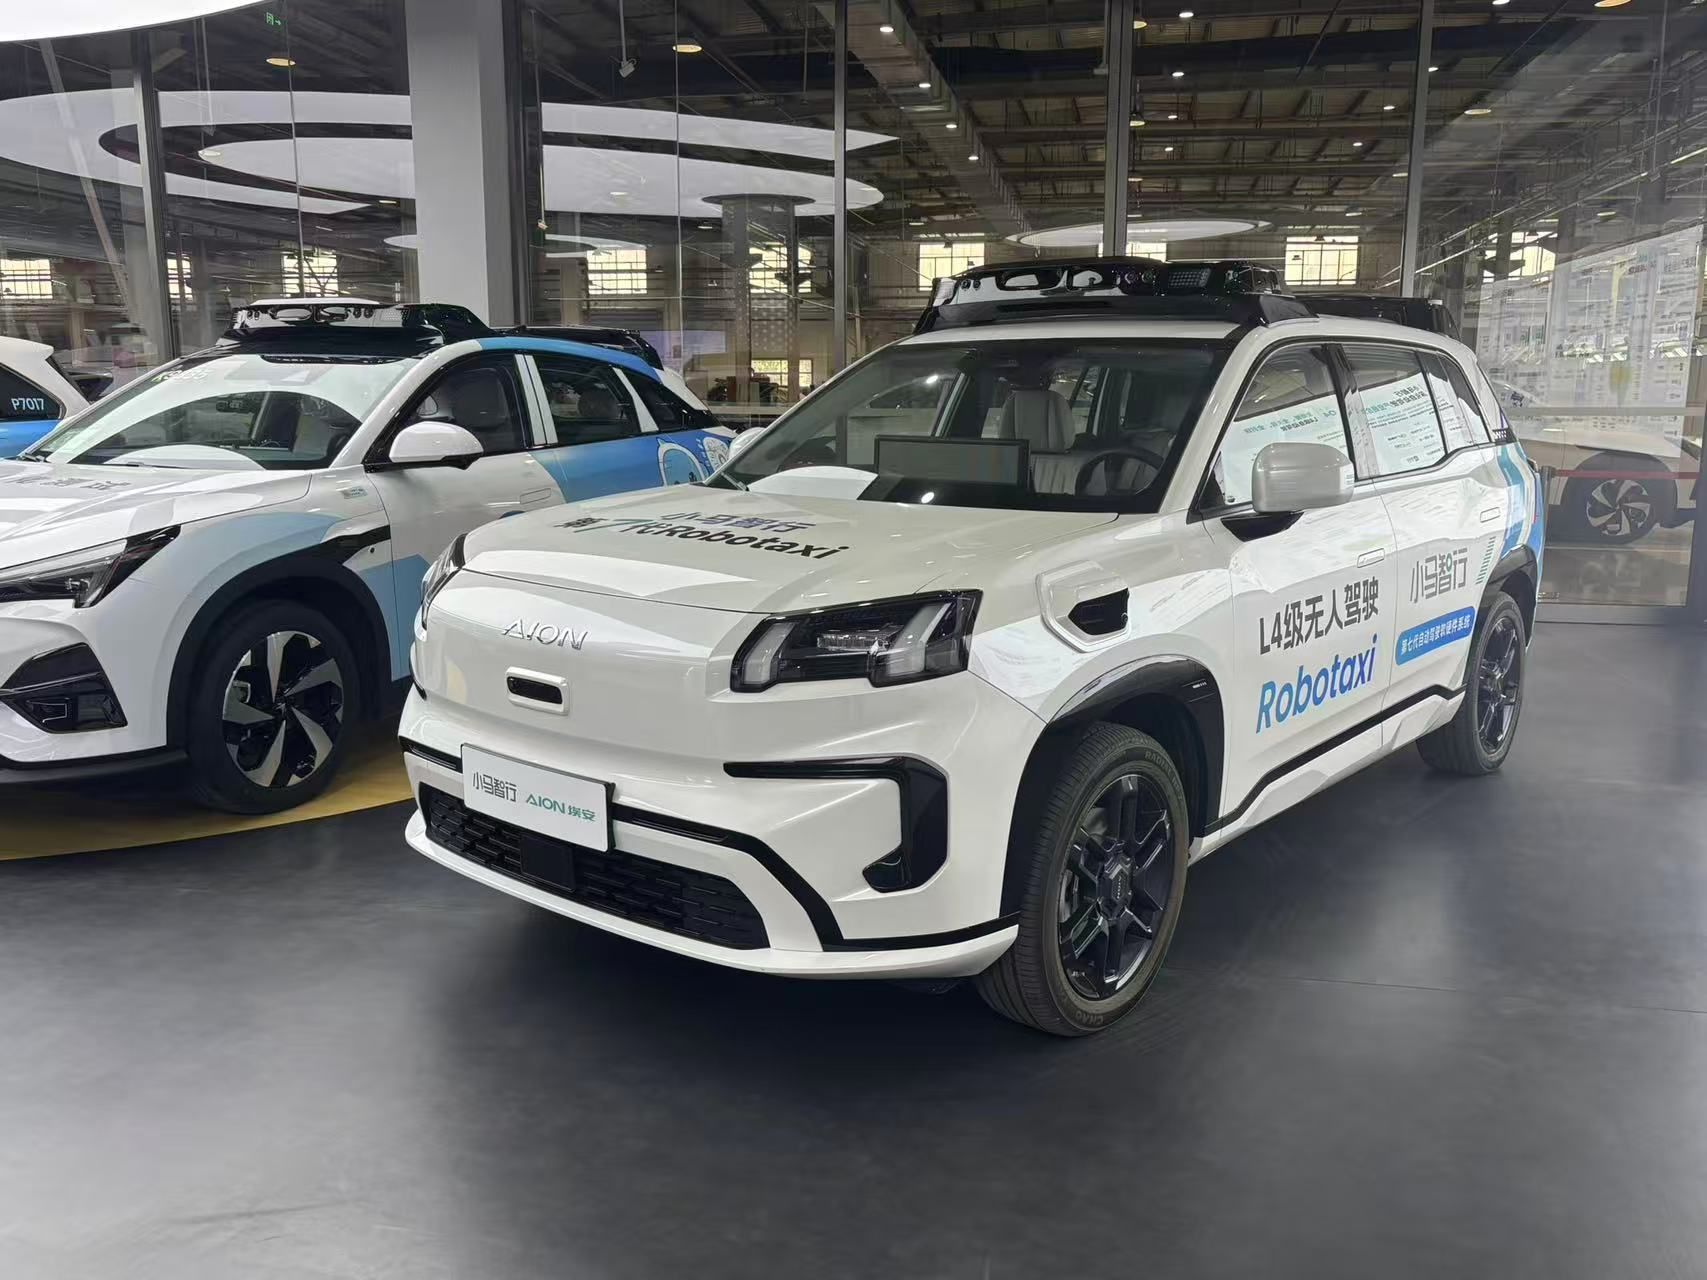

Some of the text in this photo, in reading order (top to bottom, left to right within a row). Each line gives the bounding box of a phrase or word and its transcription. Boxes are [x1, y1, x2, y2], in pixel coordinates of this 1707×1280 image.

[11, 398, 45, 411] P7017
[660, 511, 816, 533] 小马智行
[1410, 547, 1468, 604] 小马智行
[501, 618, 589, 651] AION
[1259, 576, 1379, 655] L4级无人驾驶
[1256, 633, 1378, 733] Robotaxi
[472, 771, 597, 822] 小马智行 AION 埃安
